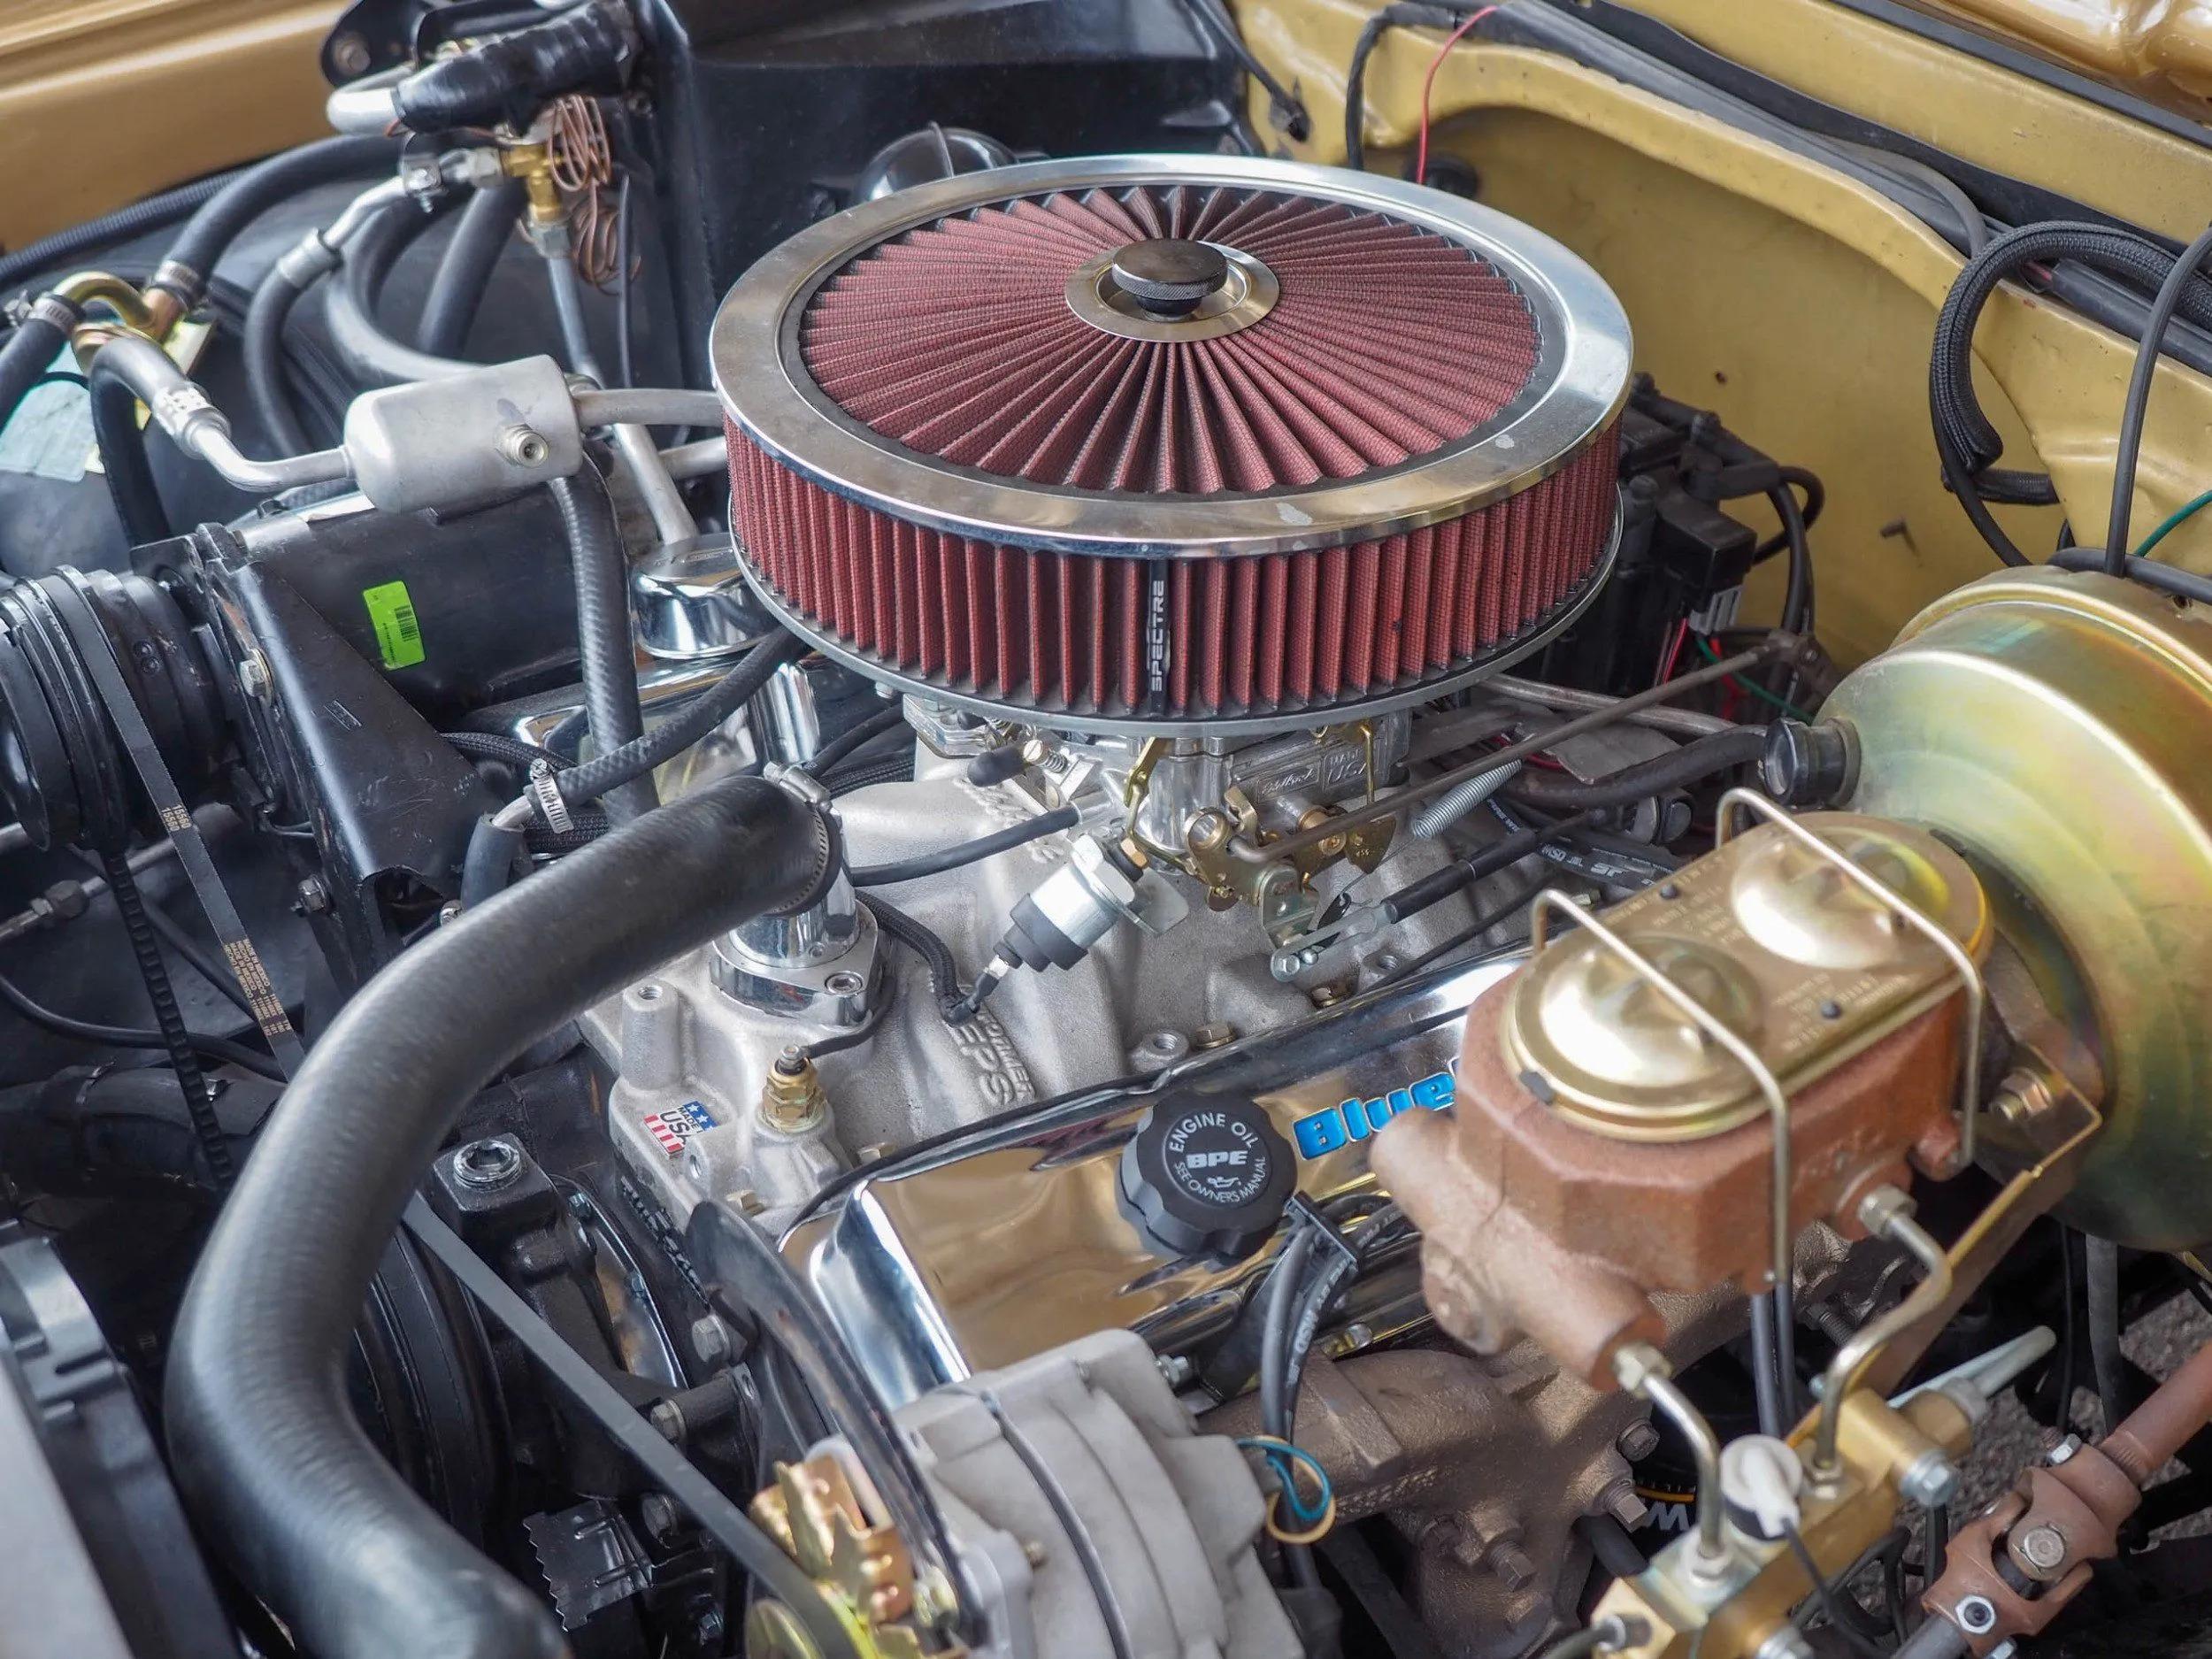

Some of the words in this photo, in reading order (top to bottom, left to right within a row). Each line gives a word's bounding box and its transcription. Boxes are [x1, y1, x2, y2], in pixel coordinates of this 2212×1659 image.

[1151, 580, 1164, 692] SPECTRE
[677, 1106, 698, 1129] MADE
[1169, 1112, 1225, 1153] ENGINE
[1231, 1122, 1258, 1148] OIL
[1174, 1162, 1192, 1181] SEE
[1189, 1180, 1240, 1202] OWNERS
[1240, 1156, 1266, 1198] MANUAL
[1187, 1150, 1248, 1169] BPE
